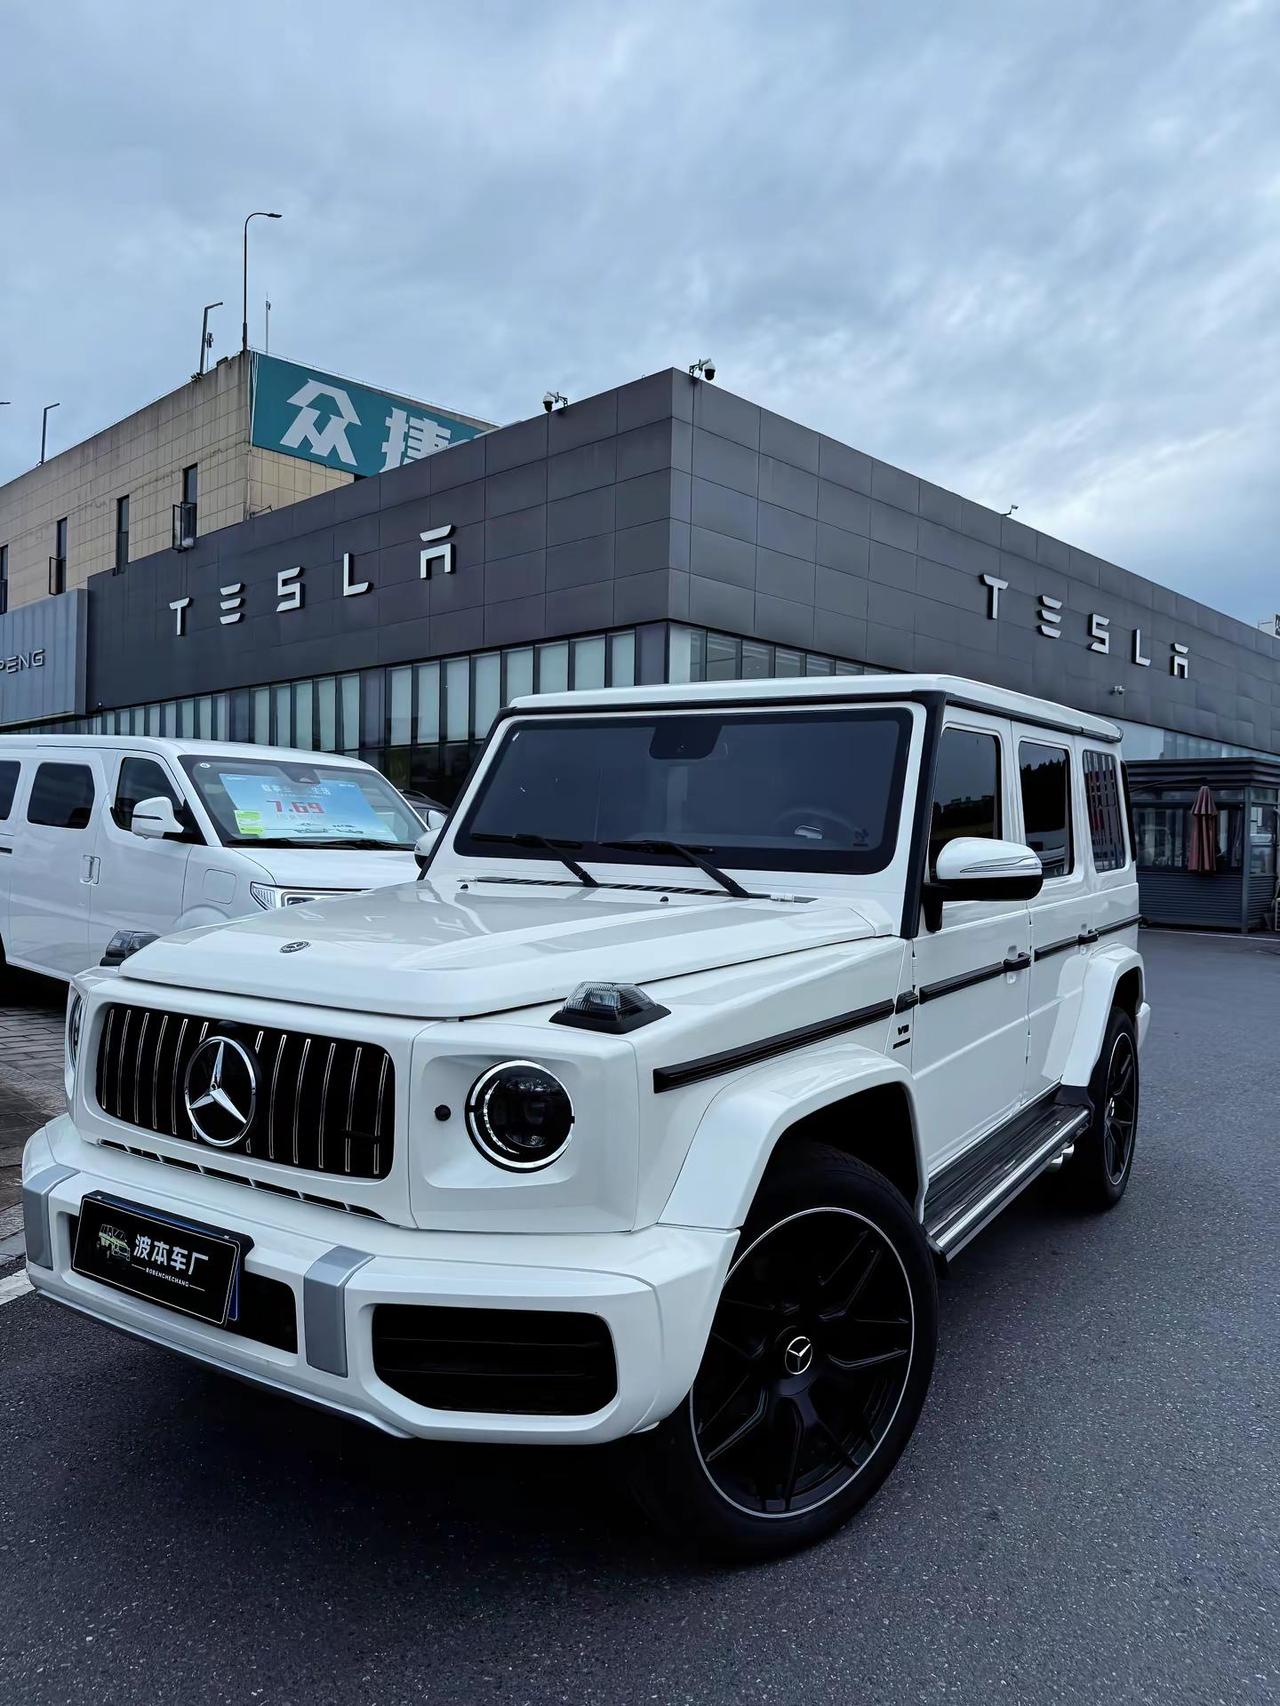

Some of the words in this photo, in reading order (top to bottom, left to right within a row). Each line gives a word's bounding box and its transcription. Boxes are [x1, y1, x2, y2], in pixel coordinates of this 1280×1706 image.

[168, 524, 453, 637] TESLA
[981, 573, 1190, 680] TESLA
[266, 800, 326, 814] 7.69
[133, 1233, 209, 1275] 波本车厂
